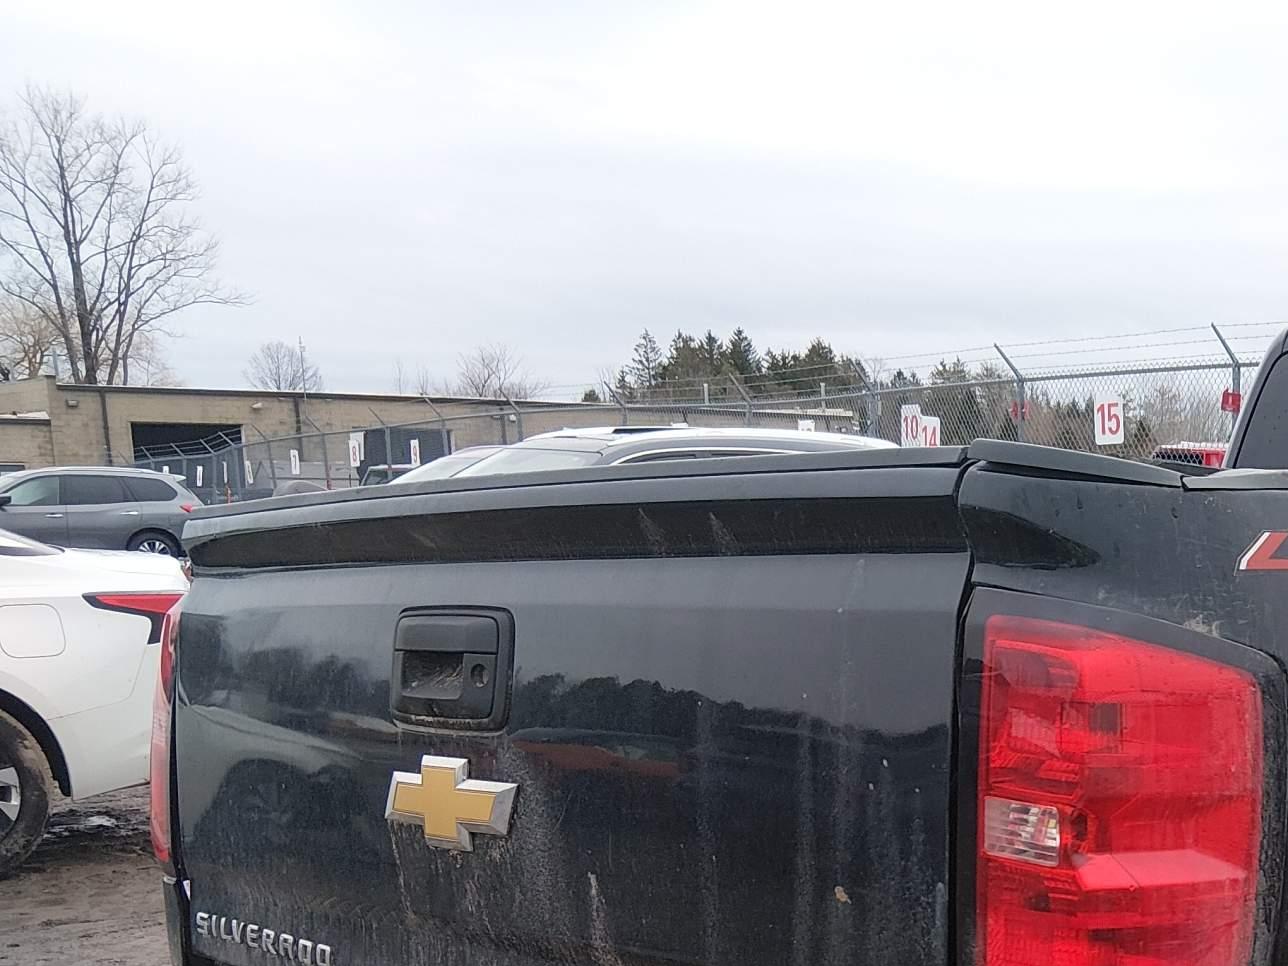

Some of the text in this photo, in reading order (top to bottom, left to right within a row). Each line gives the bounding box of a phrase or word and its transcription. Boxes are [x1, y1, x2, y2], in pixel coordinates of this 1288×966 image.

[903, 415, 919, 441] 10
[1097, 402, 1121, 436] 15
[921, 424, 938, 447] 14
